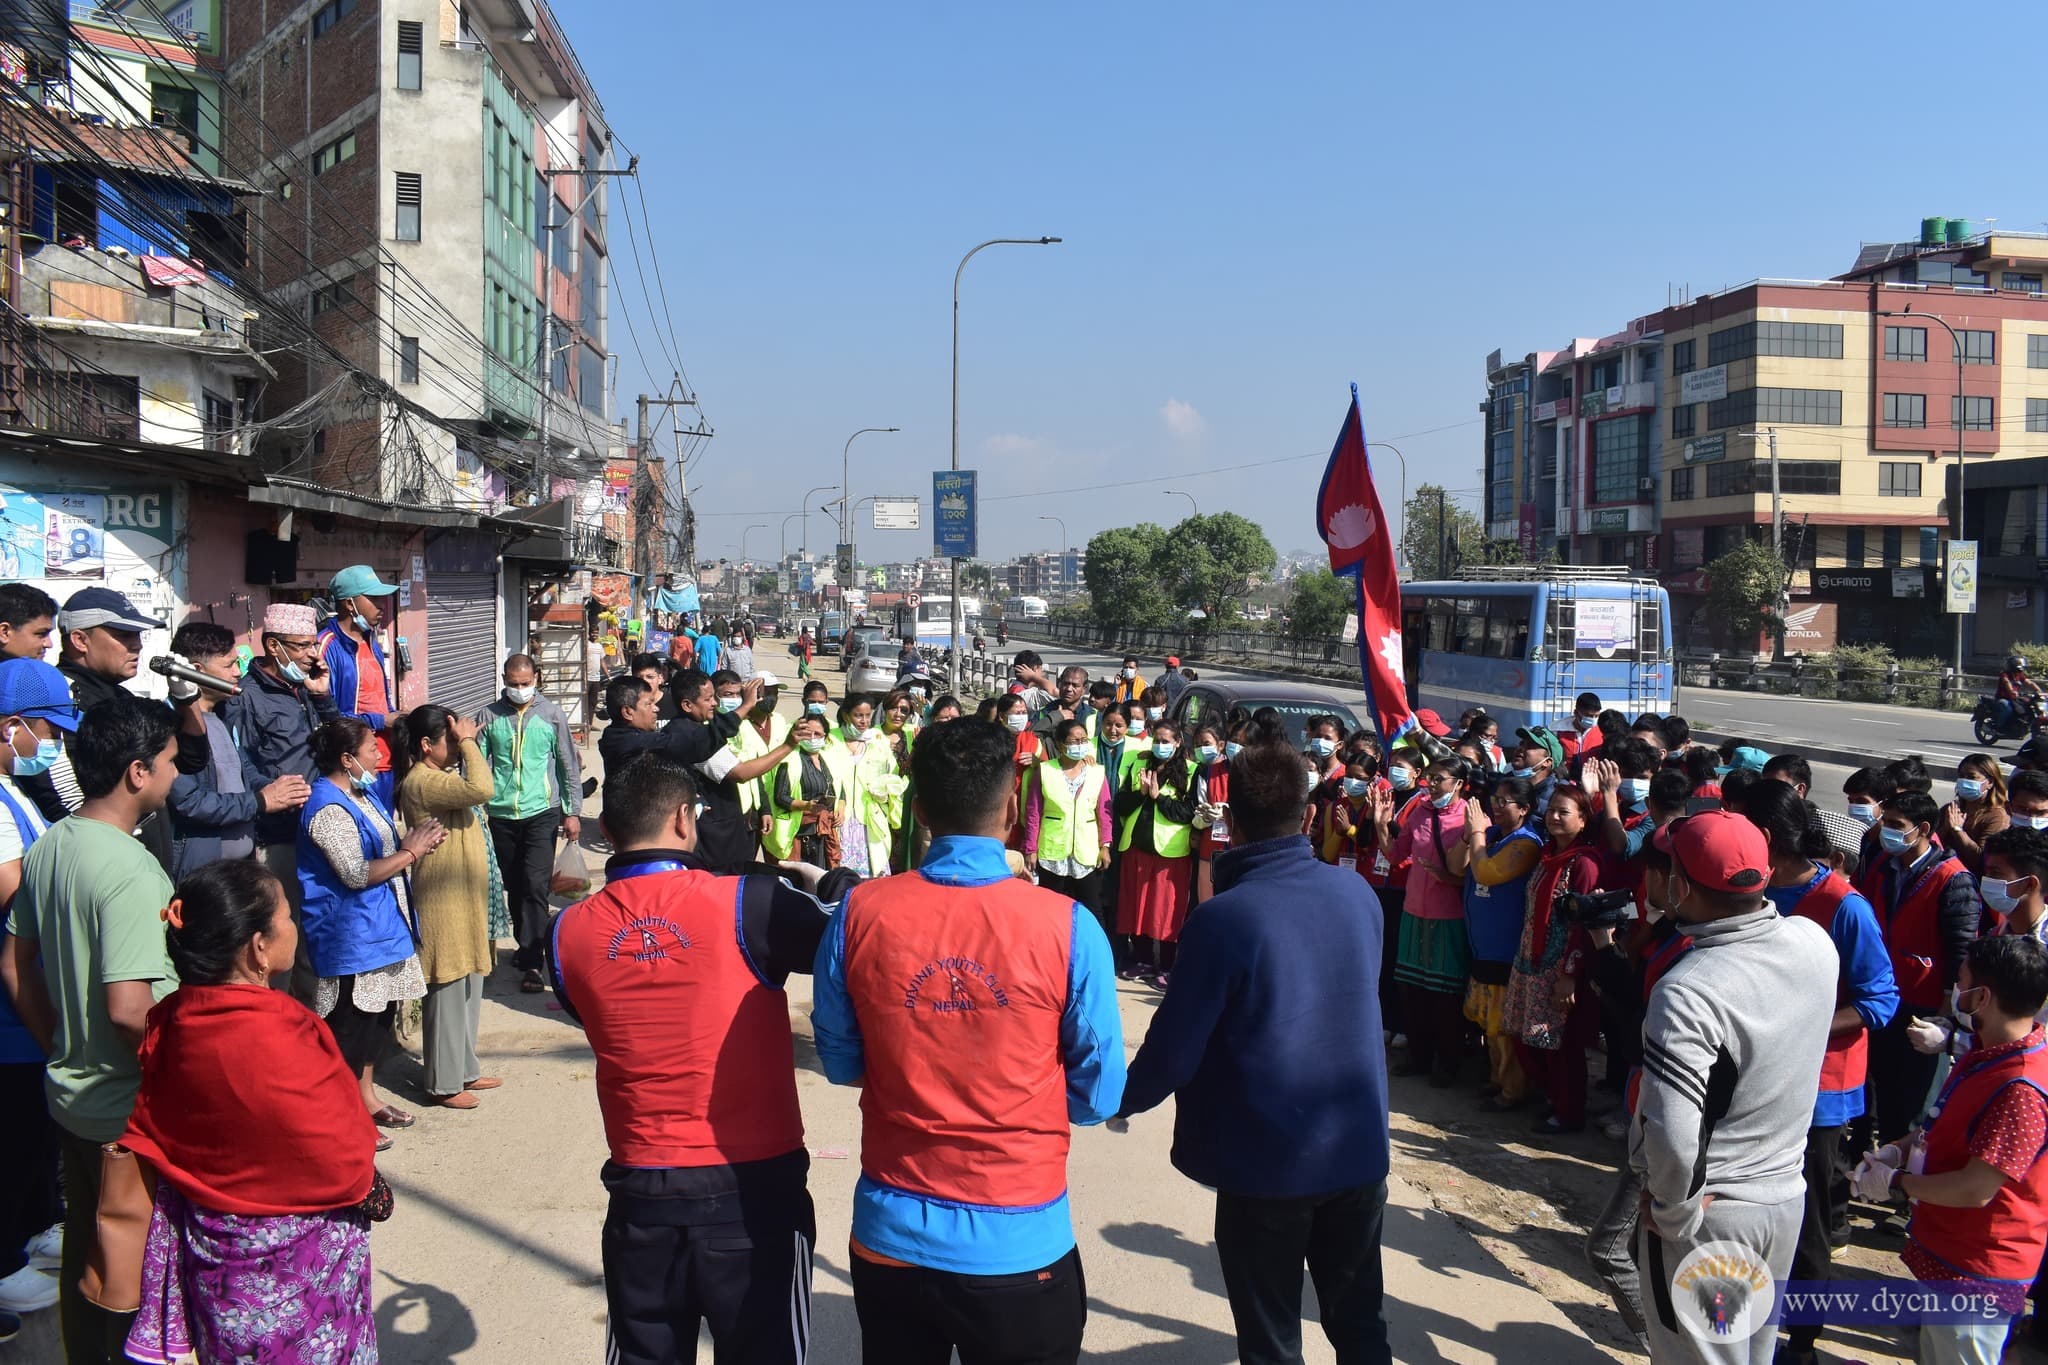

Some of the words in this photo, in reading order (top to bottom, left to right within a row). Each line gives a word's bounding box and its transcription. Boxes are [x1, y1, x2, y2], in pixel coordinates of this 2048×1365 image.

[70, 528, 91, 557] 8
[1951, 551, 1975, 560] VOICE
[1830, 577, 1872, 587] CFMOTO
[608, 926, 630, 960] DIVINE
[631, 916, 668, 930] YOUTH
[668, 923, 692, 949] CLUB
[634, 949, 669, 962] NEPAL
[905, 963, 936, 1009] DIVINE
[936, 957, 984, 977] YOUTH
[984, 973, 1009, 1008] CLUB
[933, 1000, 977, 1012] NEPAL
